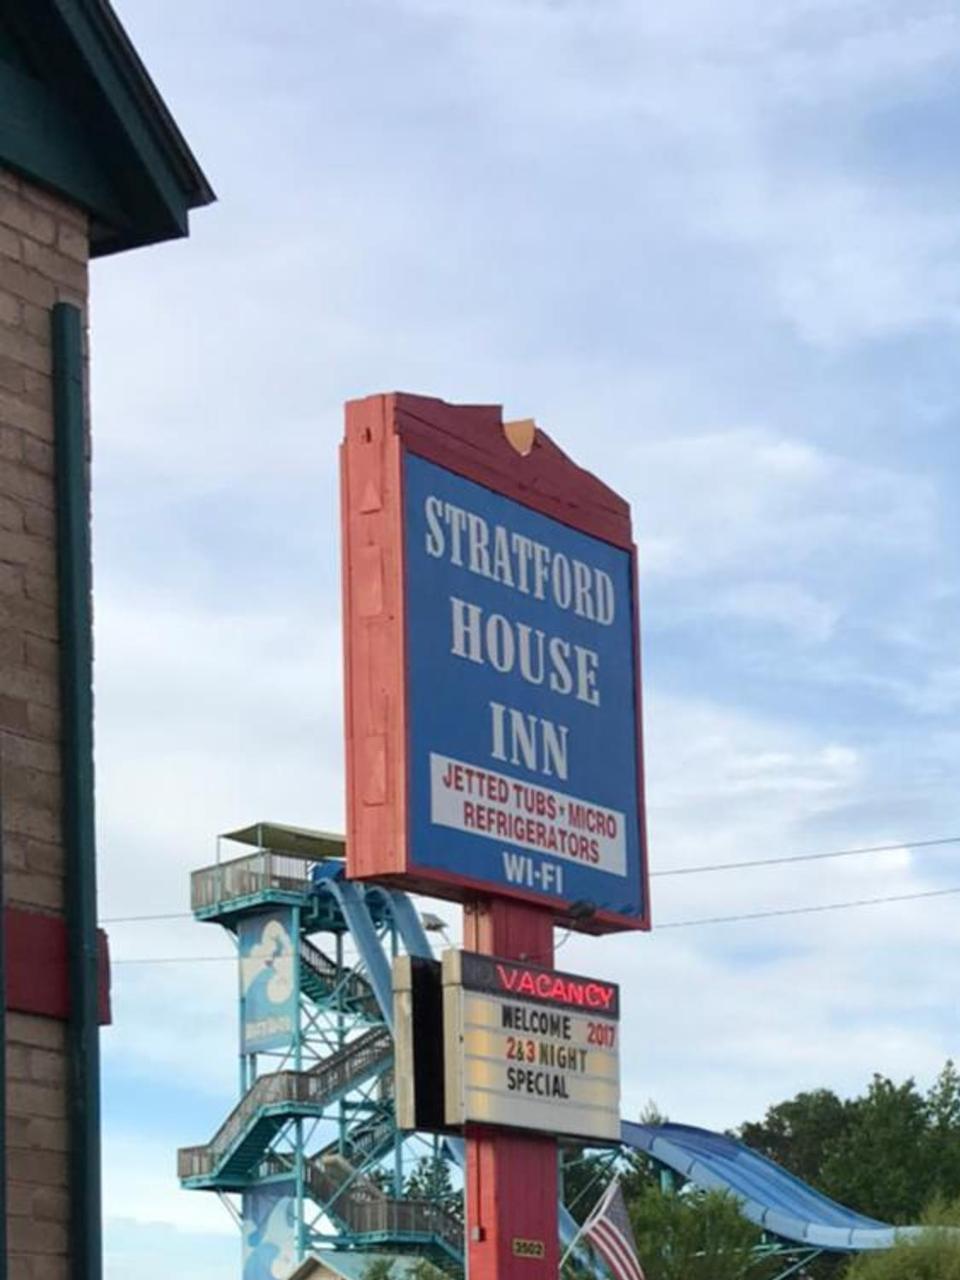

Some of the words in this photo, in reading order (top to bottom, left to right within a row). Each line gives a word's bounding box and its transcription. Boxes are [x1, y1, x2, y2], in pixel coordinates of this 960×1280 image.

[424, 495, 616, 626] STRATFORD
[450, 596, 600, 707] HOUSE
[489, 701, 569, 780] INN
[442, 762, 509, 802] JETTED
[513, 784, 556, 820] TUBS
[568, 802, 617, 839] MICRO
[463, 801, 600, 864] REFRIGERATORS
[503, 852, 563, 894] WI-FI
[496, 964, 614, 1008] VACANCY
[502, 1004, 571, 1041] WELCOME
[587, 1022, 616, 1048] 2017
[507, 1067, 569, 1099] SPECIAL
[539, 1041, 588, 1073] NIGHT
